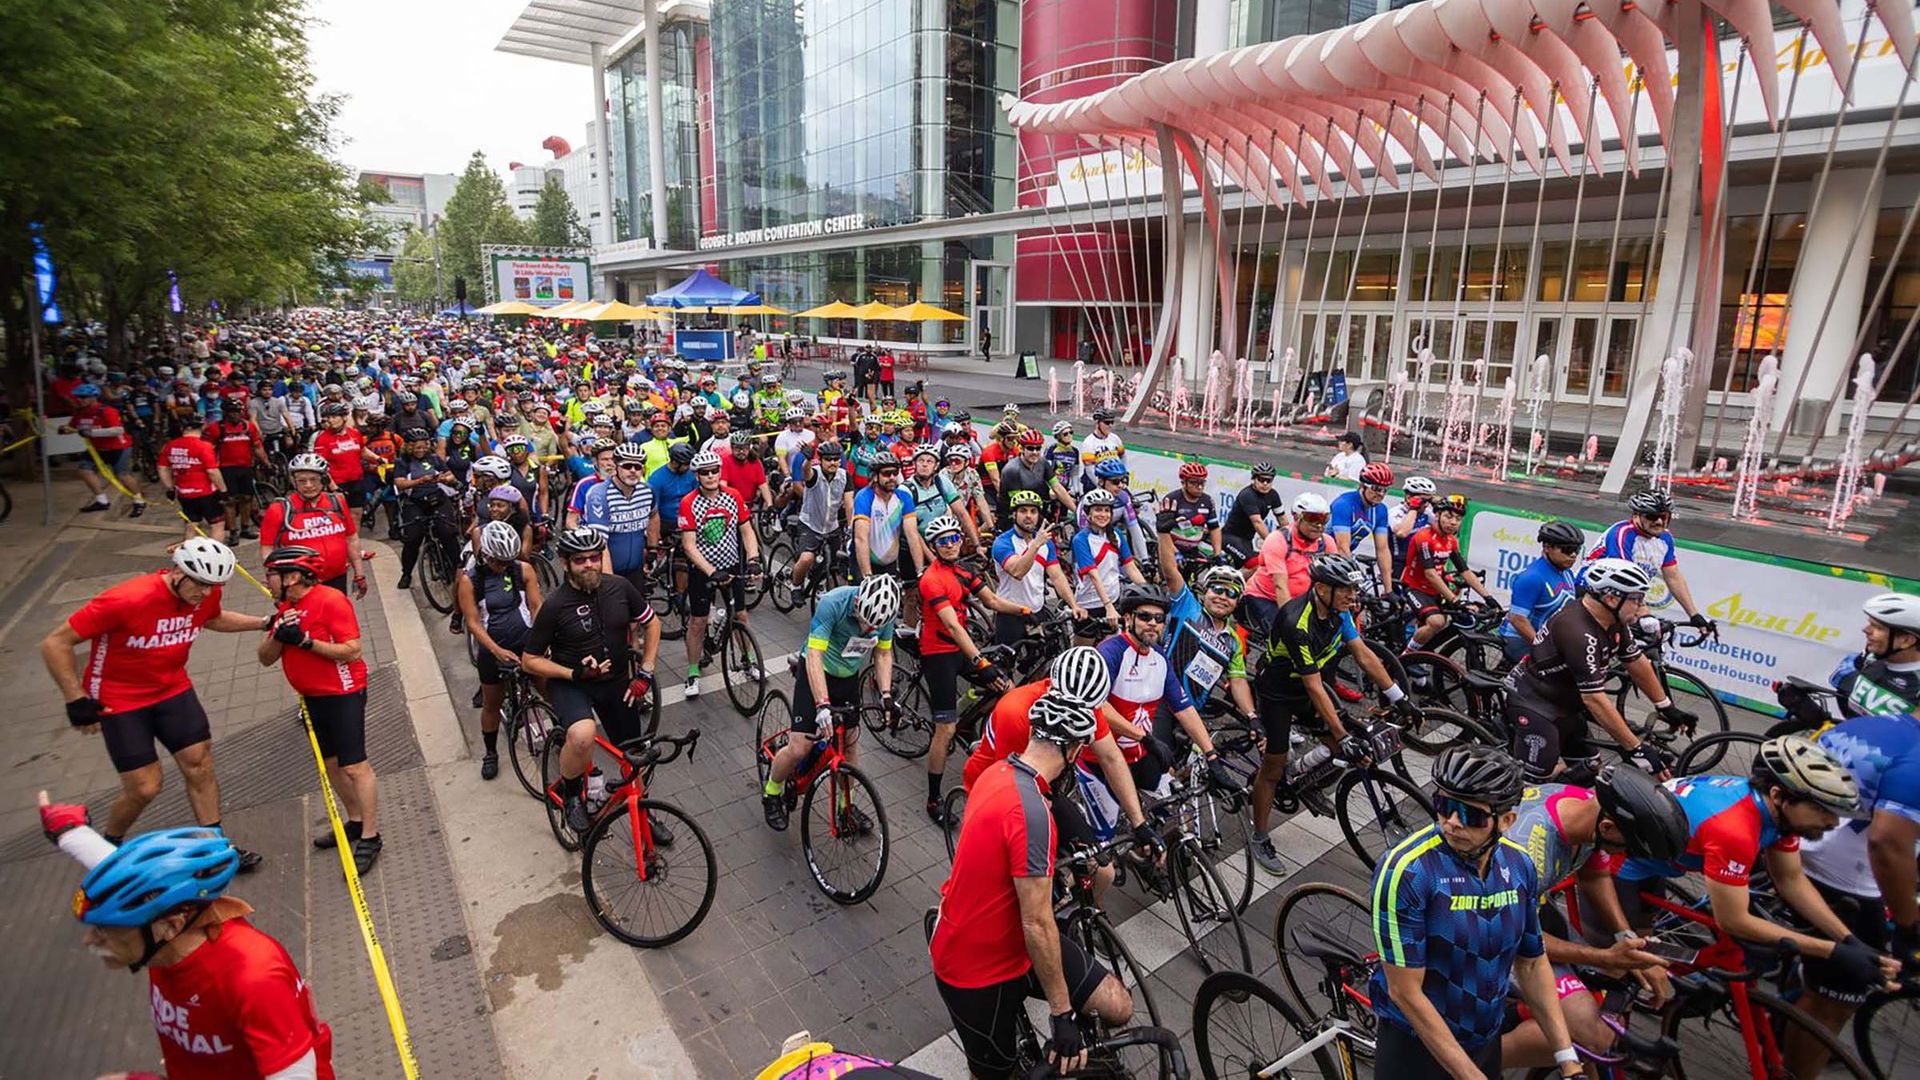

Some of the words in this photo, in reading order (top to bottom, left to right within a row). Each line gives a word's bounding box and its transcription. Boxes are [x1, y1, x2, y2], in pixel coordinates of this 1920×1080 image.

[700, 235, 726, 249] GEORGE
[735, 228, 763, 245] BROWN
[764, 219, 822, 242] CONVENTION
[824, 213, 865, 234] CENTER
[288, 523, 346, 541] MARSHAL
[156, 613, 194, 634] RIDE
[1706, 591, 1841, 642] Apache
[125, 626, 204, 650] MARSHA
[1449, 895, 1478, 912] ZOOT
[1480, 889, 1519, 910] SPORTS
